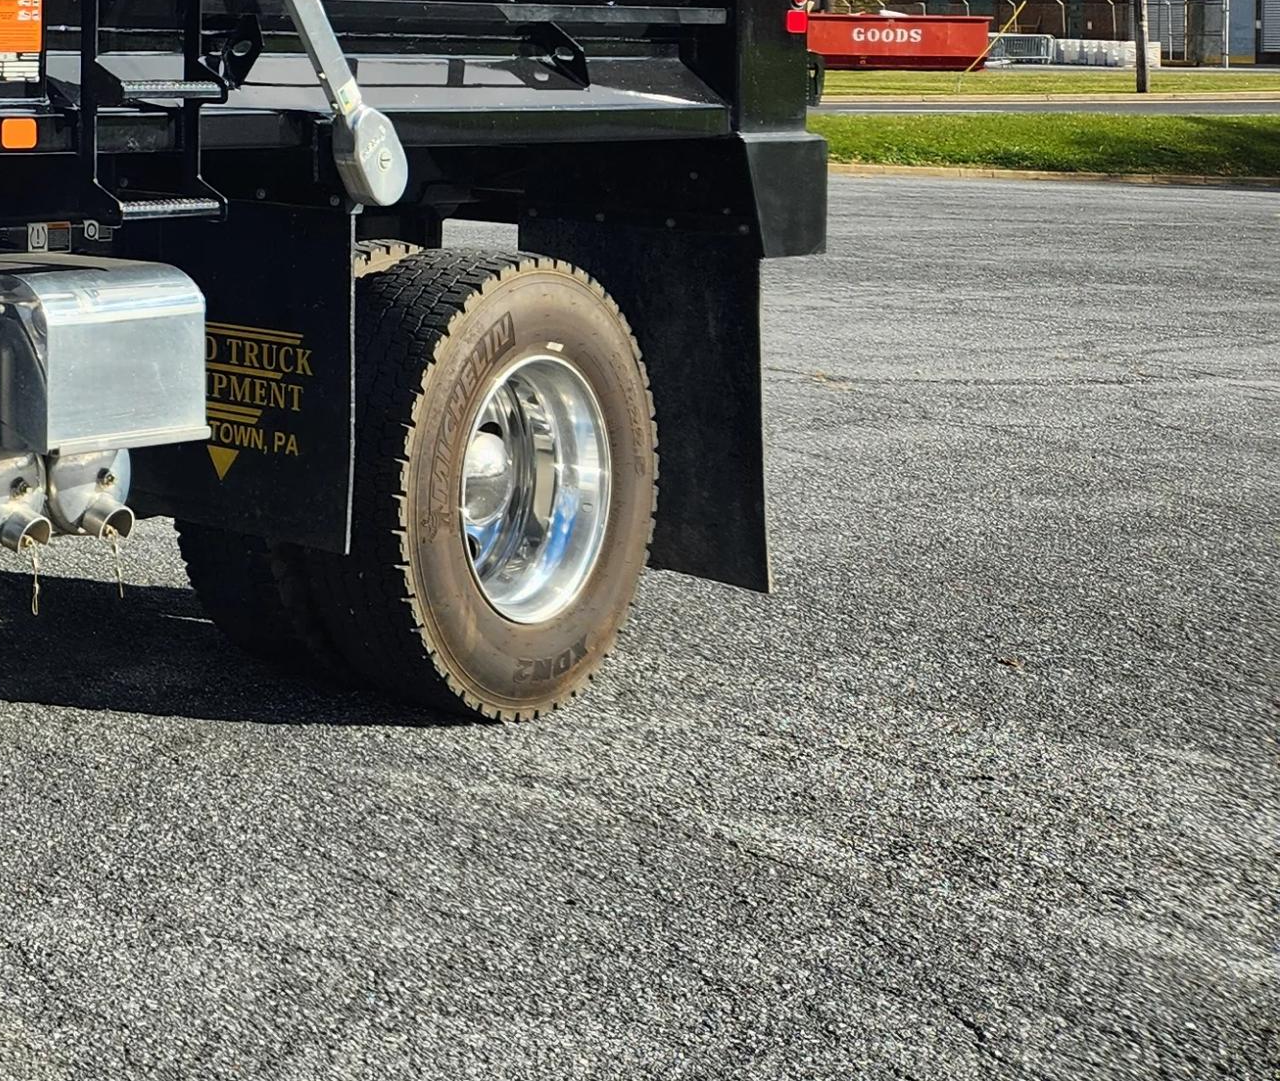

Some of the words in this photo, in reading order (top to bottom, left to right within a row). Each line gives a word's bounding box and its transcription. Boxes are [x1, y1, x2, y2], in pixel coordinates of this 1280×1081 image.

[852, 27, 922, 43] GOODS
[226, 338, 314, 376] TRUCK
[205, 371, 304, 412] IPMENT
[431, 315, 514, 505] MICHELIN
[209, 420, 268, 455] TOWN,
[273, 431, 299, 457] PA
